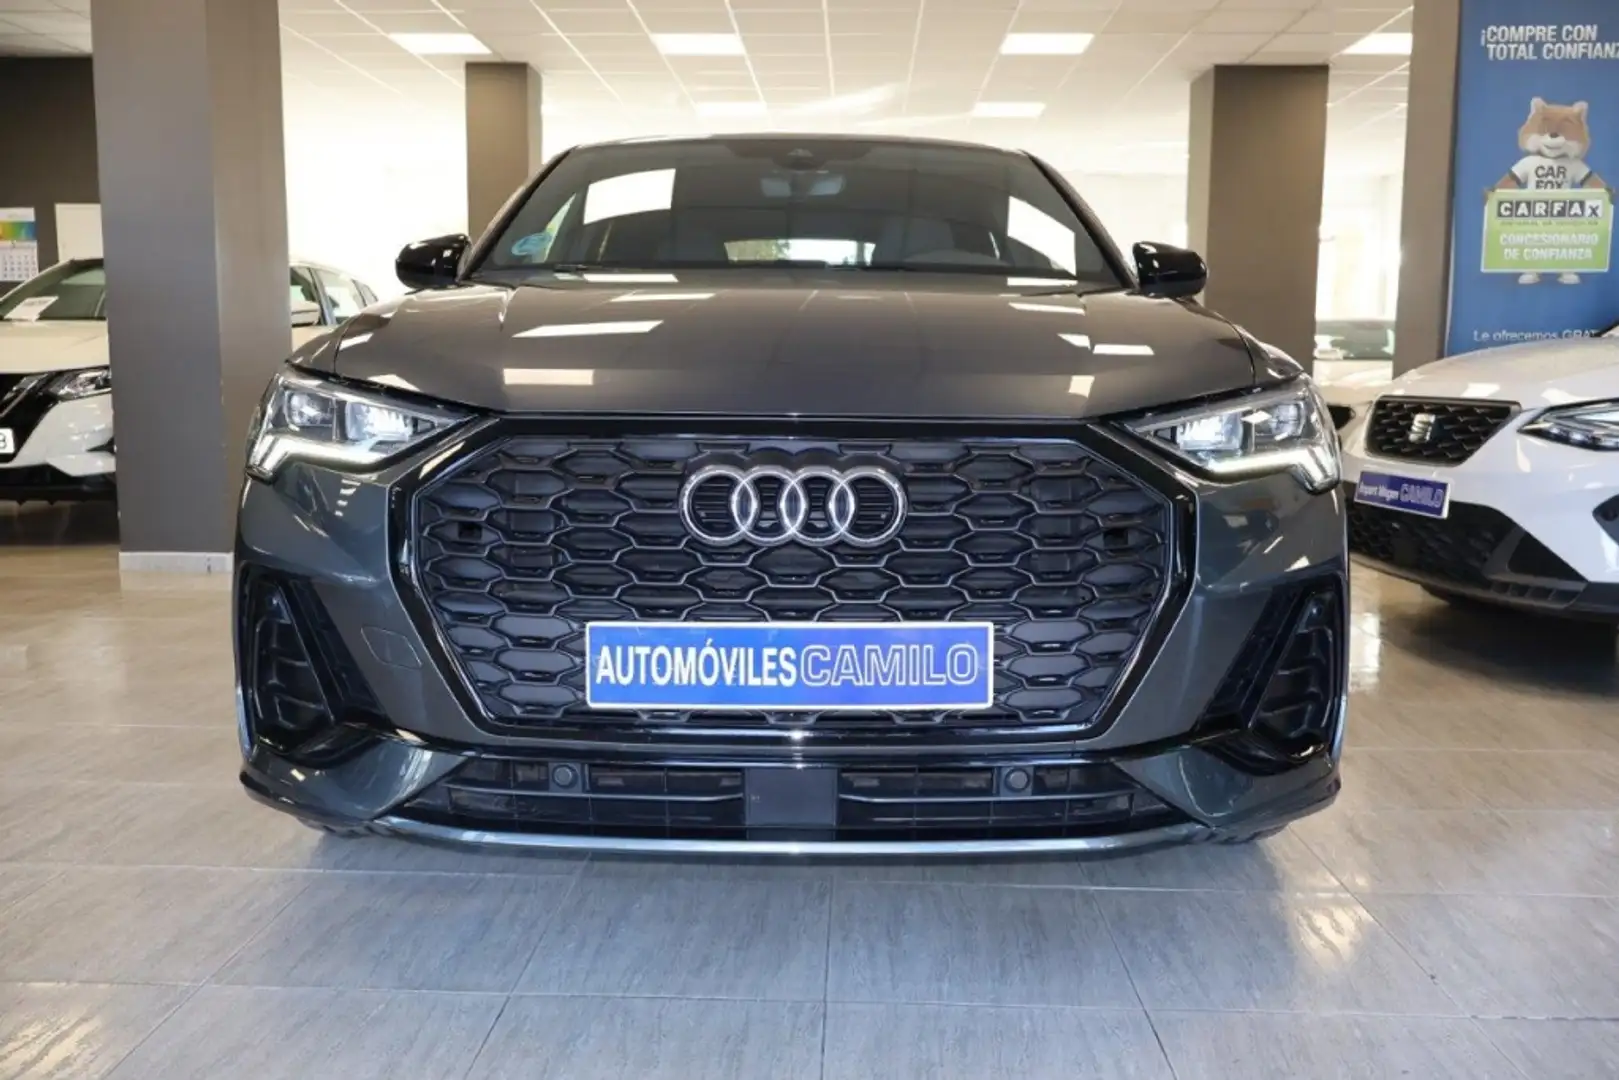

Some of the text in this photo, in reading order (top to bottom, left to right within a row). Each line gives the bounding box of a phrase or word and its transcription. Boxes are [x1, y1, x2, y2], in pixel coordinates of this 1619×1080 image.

[1481, 24, 1597, 46] ¡COMPRE CON
[1487, 43, 1537, 60] TOTAL
[1535, 165, 1566, 178] CAR
[1498, 200, 1602, 218] CARFAX
[1500, 233, 1599, 246] CONCESIONARIO
[1504, 248, 1592, 261] DE CONFIANZA
[1473, 329, 1490, 341] Le
[1492, 329, 1558, 341] ofrecemos
[596, 638, 979, 688] AUTOMÓVILES CAMILO
